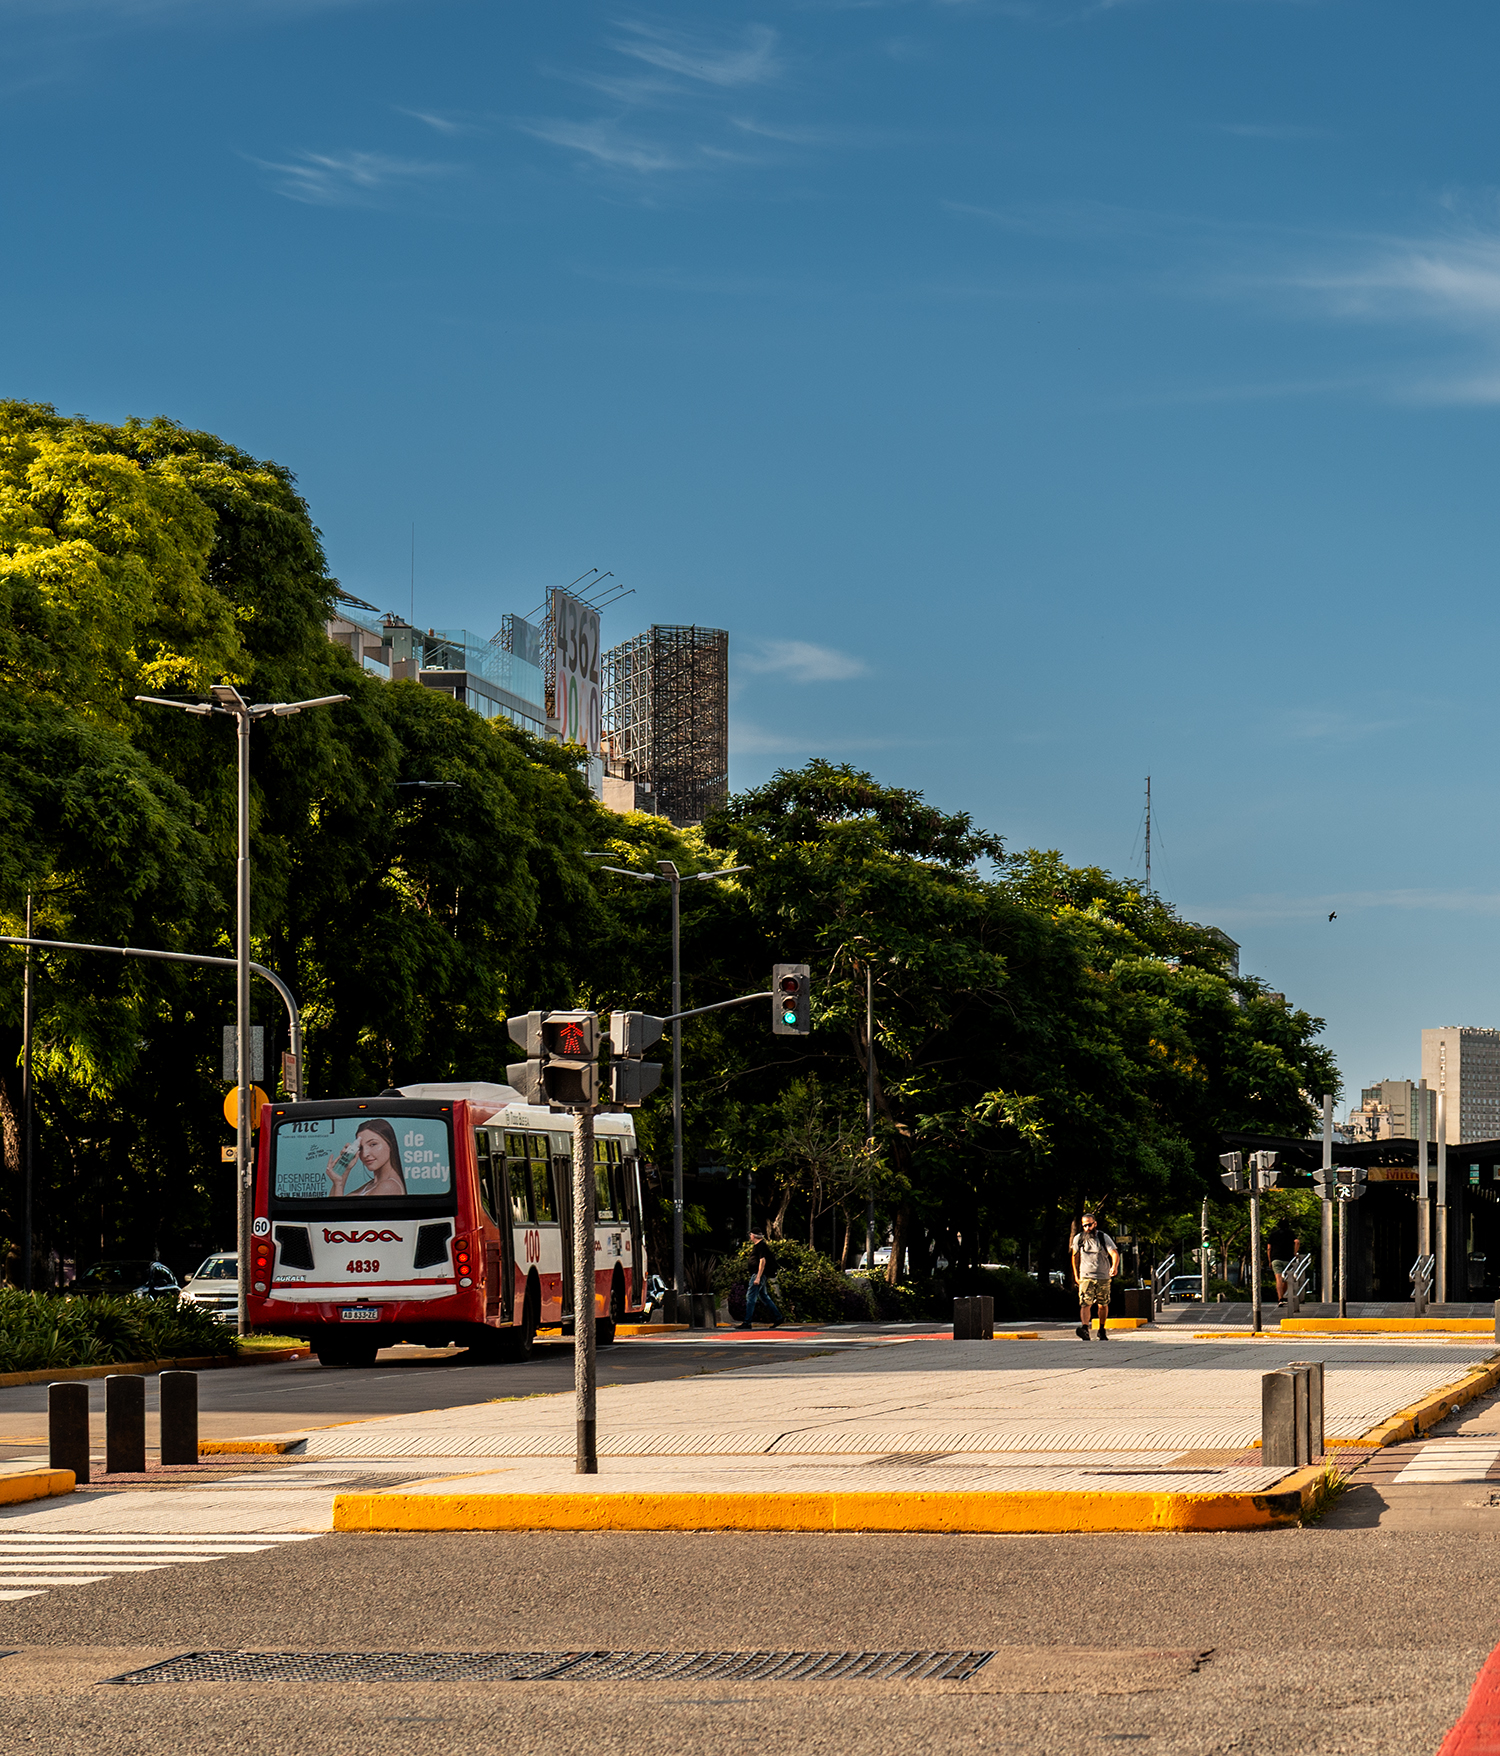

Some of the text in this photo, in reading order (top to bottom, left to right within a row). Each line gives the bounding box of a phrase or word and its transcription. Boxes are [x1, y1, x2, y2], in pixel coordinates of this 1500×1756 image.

[557, 597, 599, 686] 4362
[404, 1131, 424, 1147] de
[404, 1150, 440, 1163] sen-
[277, 1173, 327, 1183] DESENREDA
[404, 1163, 450, 1182] ready
[277, 1183, 286, 1192] AL
[254, 1221, 268, 1233] 60
[524, 1230, 541, 1263] 100
[346, 1260, 381, 1273] 4839
